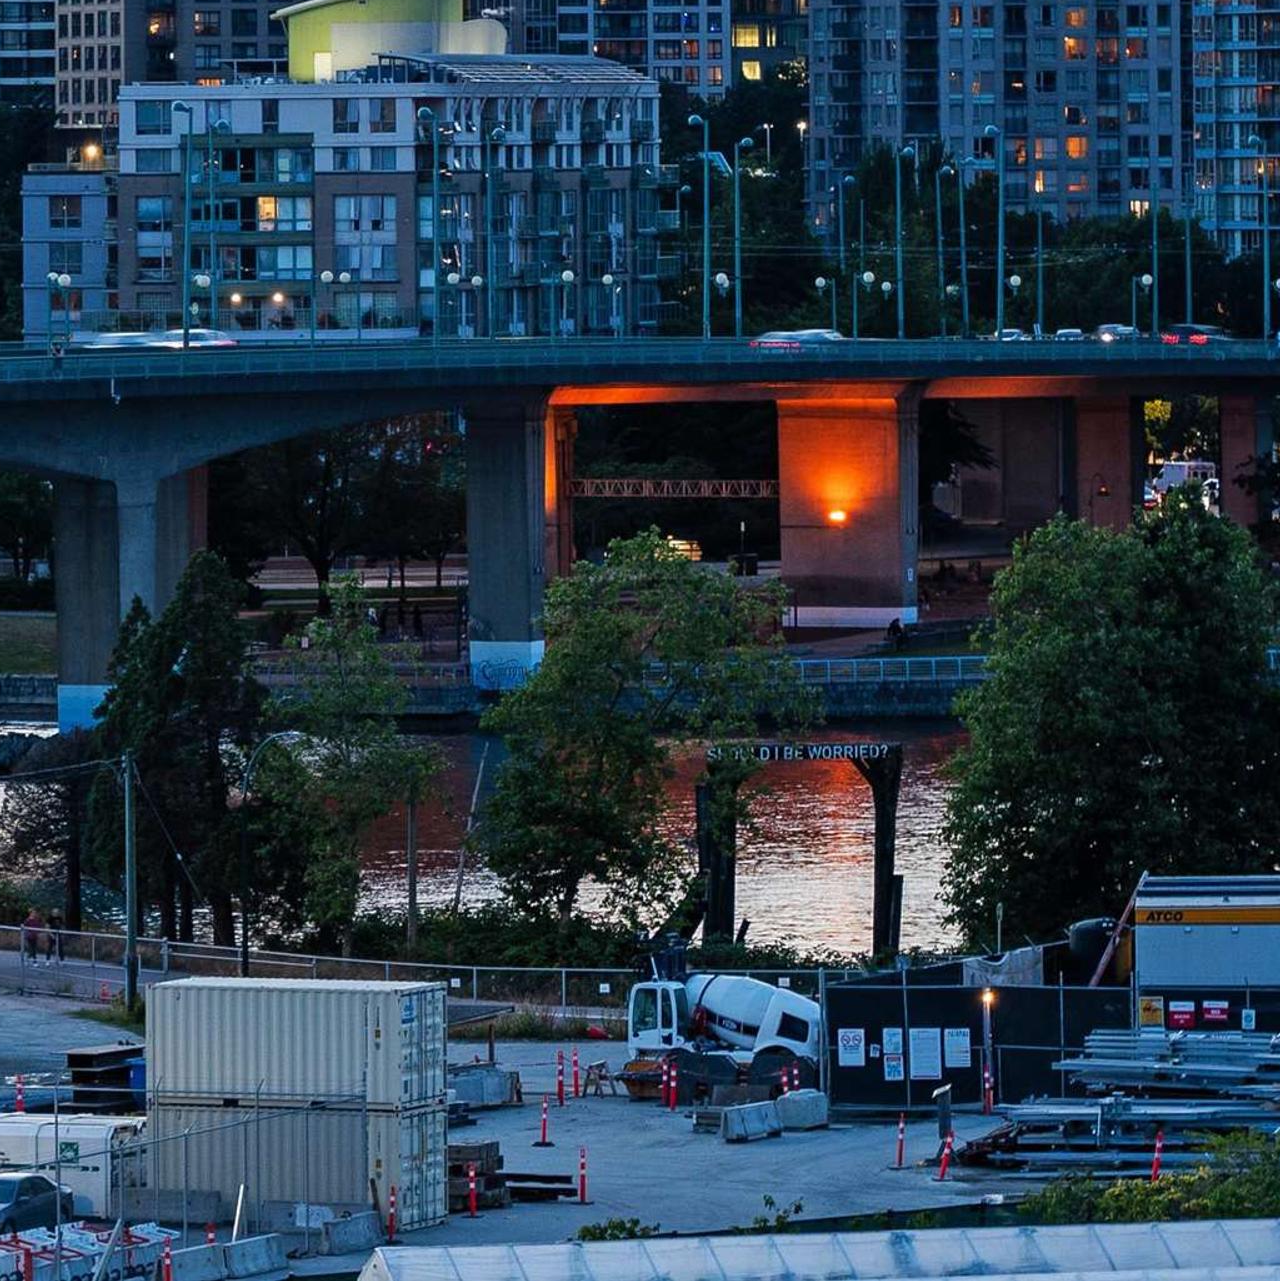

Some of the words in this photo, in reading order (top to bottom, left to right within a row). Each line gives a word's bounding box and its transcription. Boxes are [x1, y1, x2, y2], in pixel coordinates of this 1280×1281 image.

[783, 747, 805, 760] BE
[807, 744, 889, 760] WORRIED?
[1146, 911, 1184, 922] ATCO
